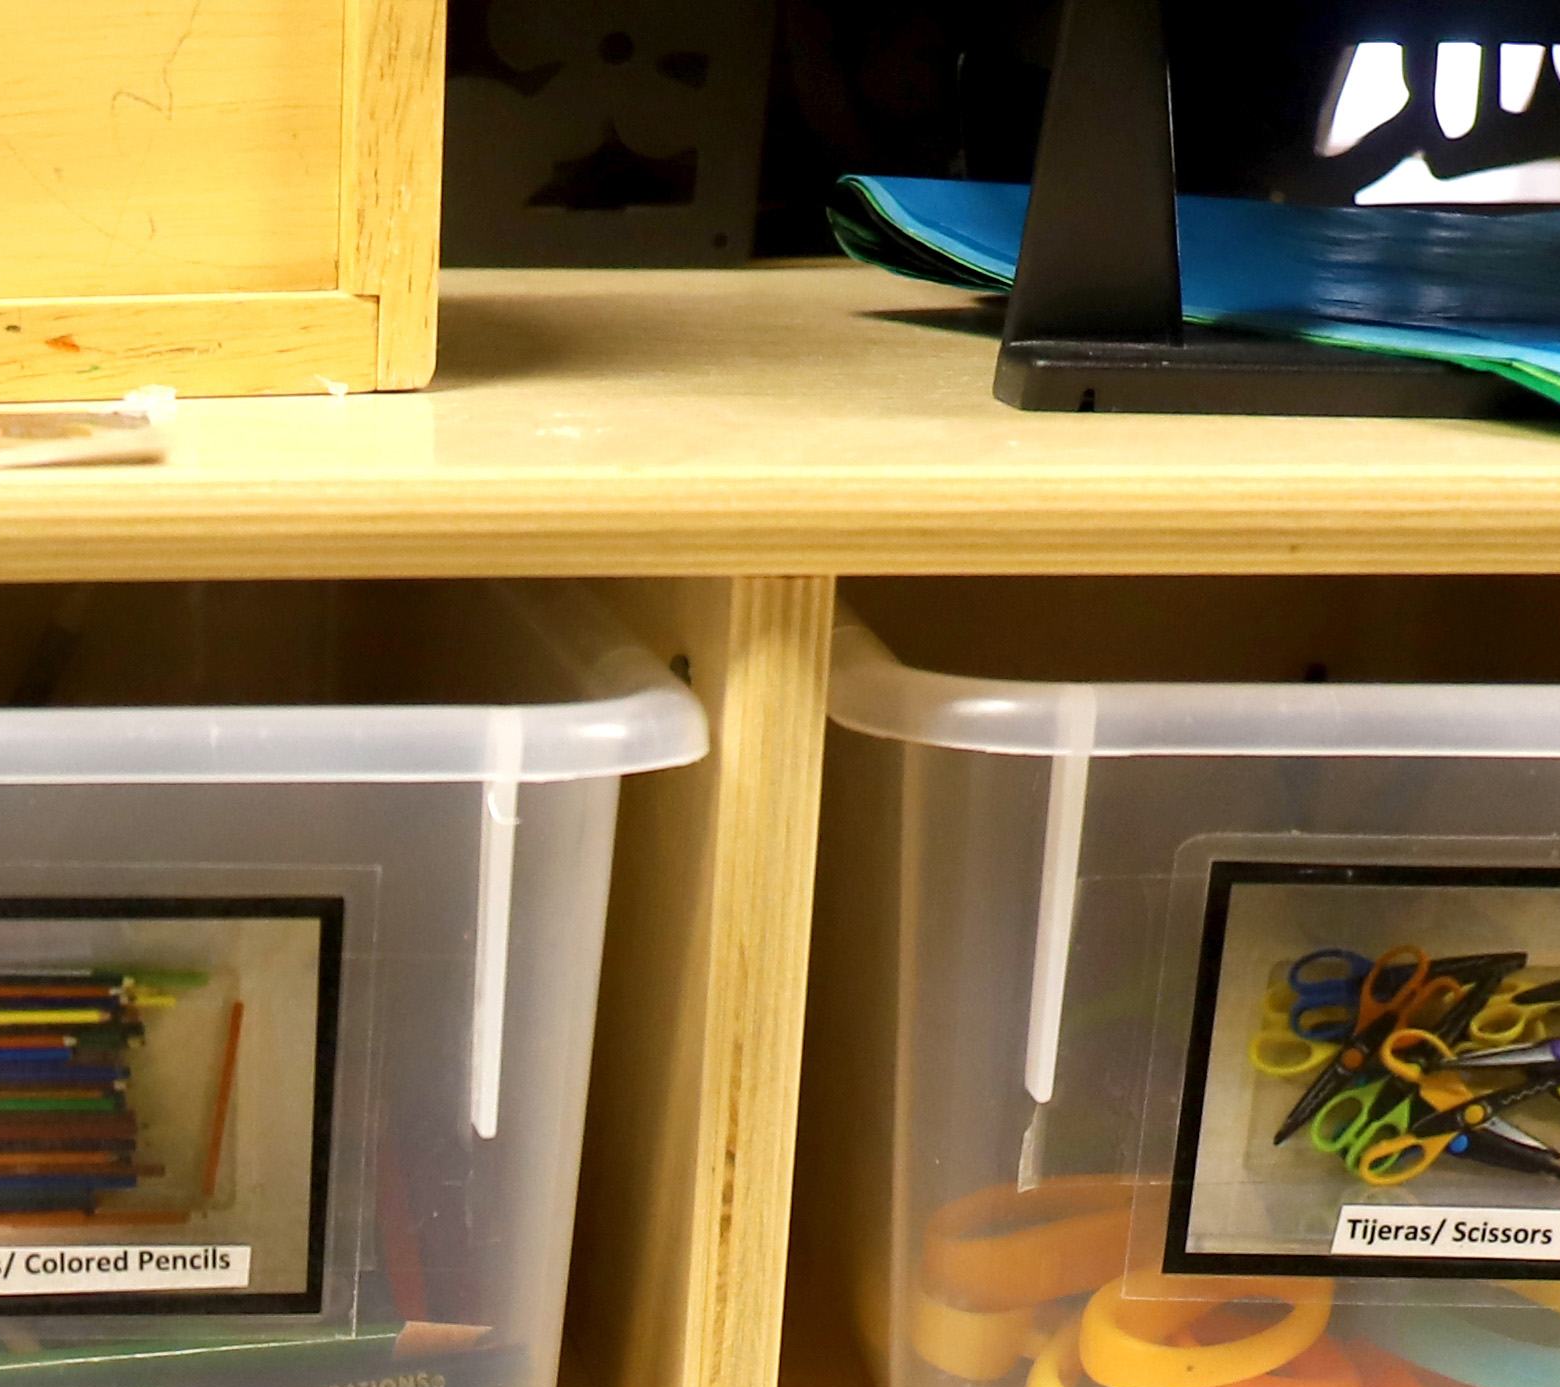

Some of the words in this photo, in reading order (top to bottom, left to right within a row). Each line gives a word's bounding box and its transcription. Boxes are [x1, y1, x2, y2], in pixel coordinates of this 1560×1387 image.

[1347, 1219, 1447, 1246] Tijeras/
[1453, 1222, 1553, 1244] Scissors
[25, 1250, 129, 1274] Colored
[139, 1247, 231, 1271] Pencils
